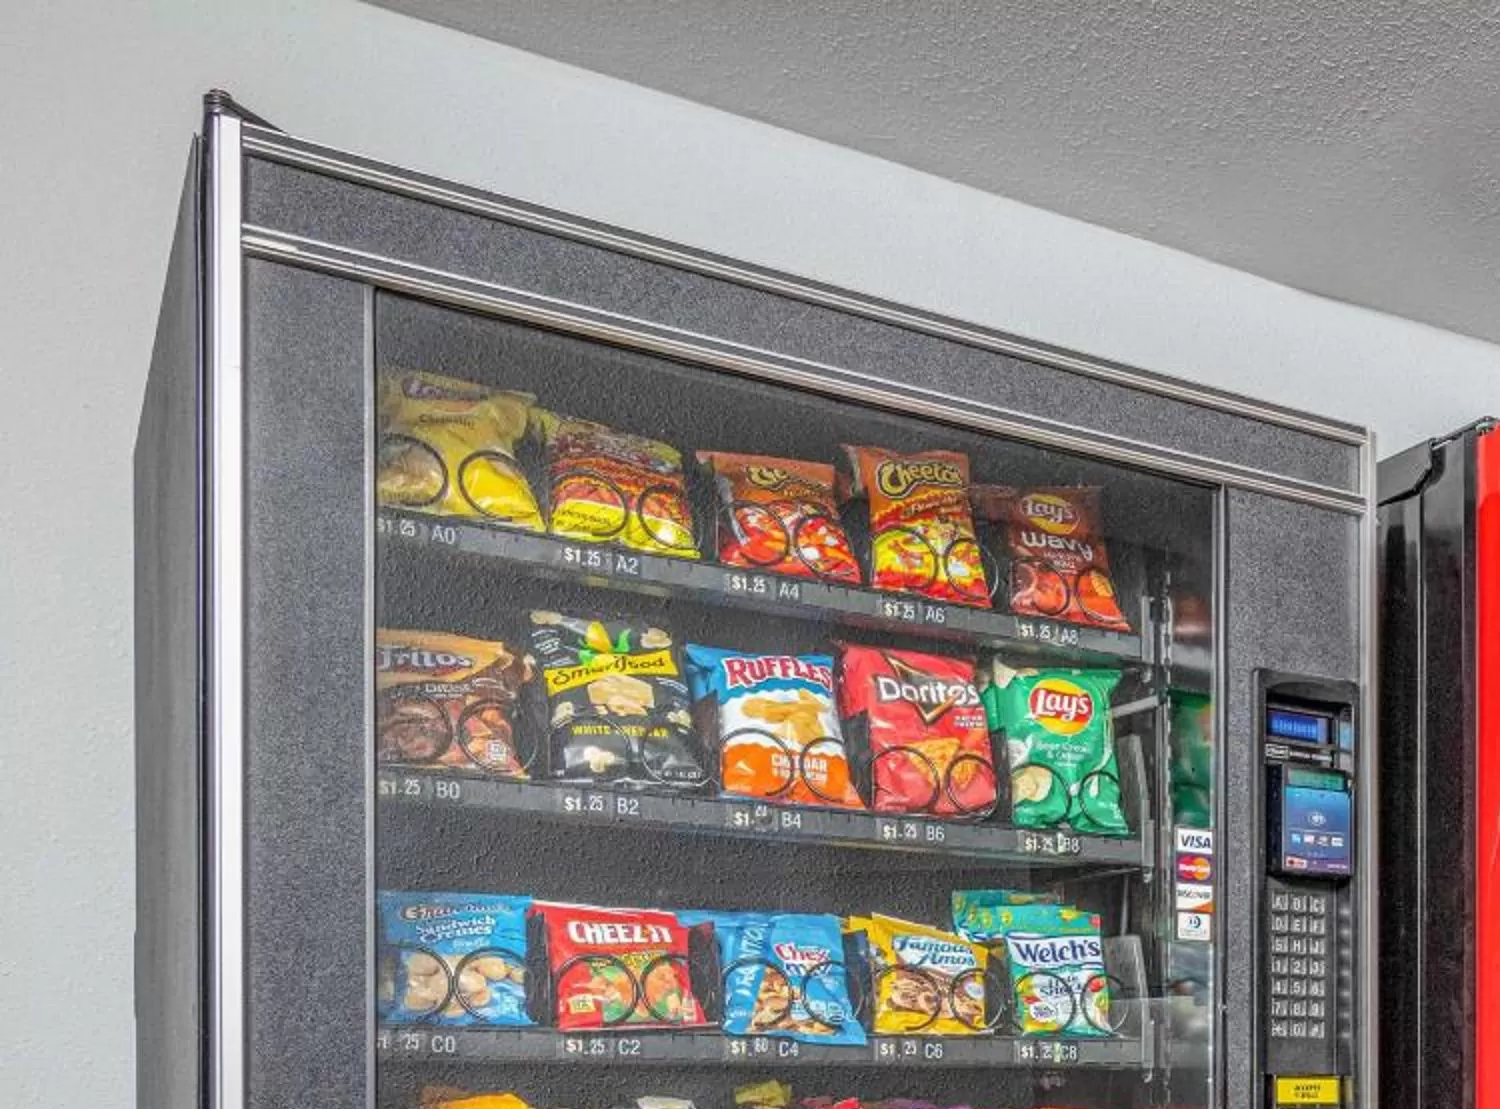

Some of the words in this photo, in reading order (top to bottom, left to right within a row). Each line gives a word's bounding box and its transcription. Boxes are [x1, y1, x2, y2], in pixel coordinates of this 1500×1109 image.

[615, 556, 639, 575] A2
[779, 582, 799, 599] A4
[925, 608, 945, 623] A6
[1060, 628, 1079, 645] A8
[724, 656, 833, 692] RUFFLES
[879, 676, 981, 706] Doritos
[571, 724, 612, 738] WHITE
[436, 781, 461, 800] B0
[564, 796, 604, 813] $1.25
[616, 797, 641, 815] B2
[781, 811, 801, 828] B4
[926, 827, 946, 842] B6
[1181, 834, 1211, 849] VISA
[1013, 939, 1100, 963] Welch's
[431, 1035, 456, 1053] C0
[565, 1039, 605, 1056] $1.25
[618, 1039, 641, 1055] C2
[778, 1042, 800, 1057] C4
[924, 1043, 944, 1059] C6
